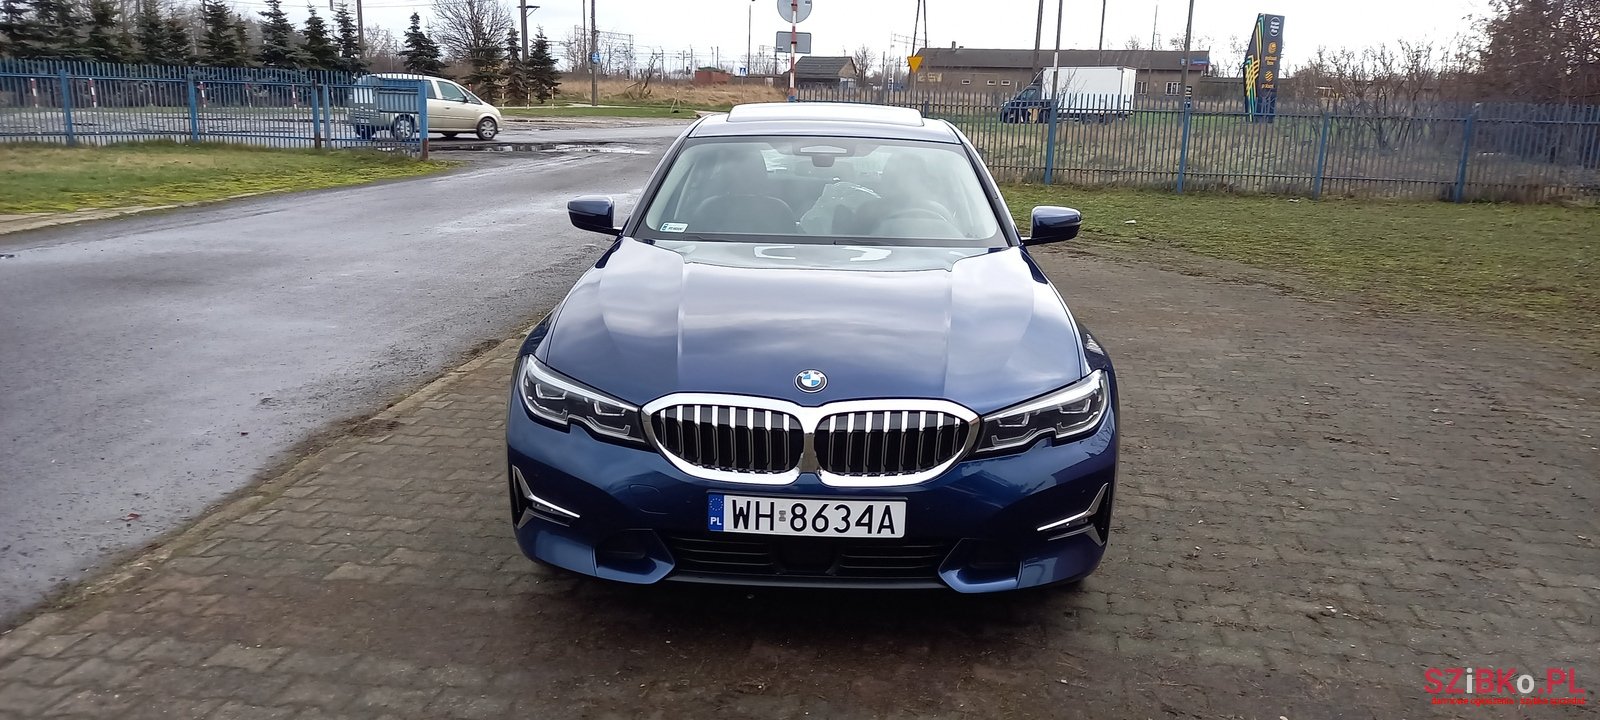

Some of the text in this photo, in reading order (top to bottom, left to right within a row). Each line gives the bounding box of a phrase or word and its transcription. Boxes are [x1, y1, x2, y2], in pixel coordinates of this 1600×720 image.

[710, 516, 722, 526] PL
[732, 499, 896, 534] WH 8634A
